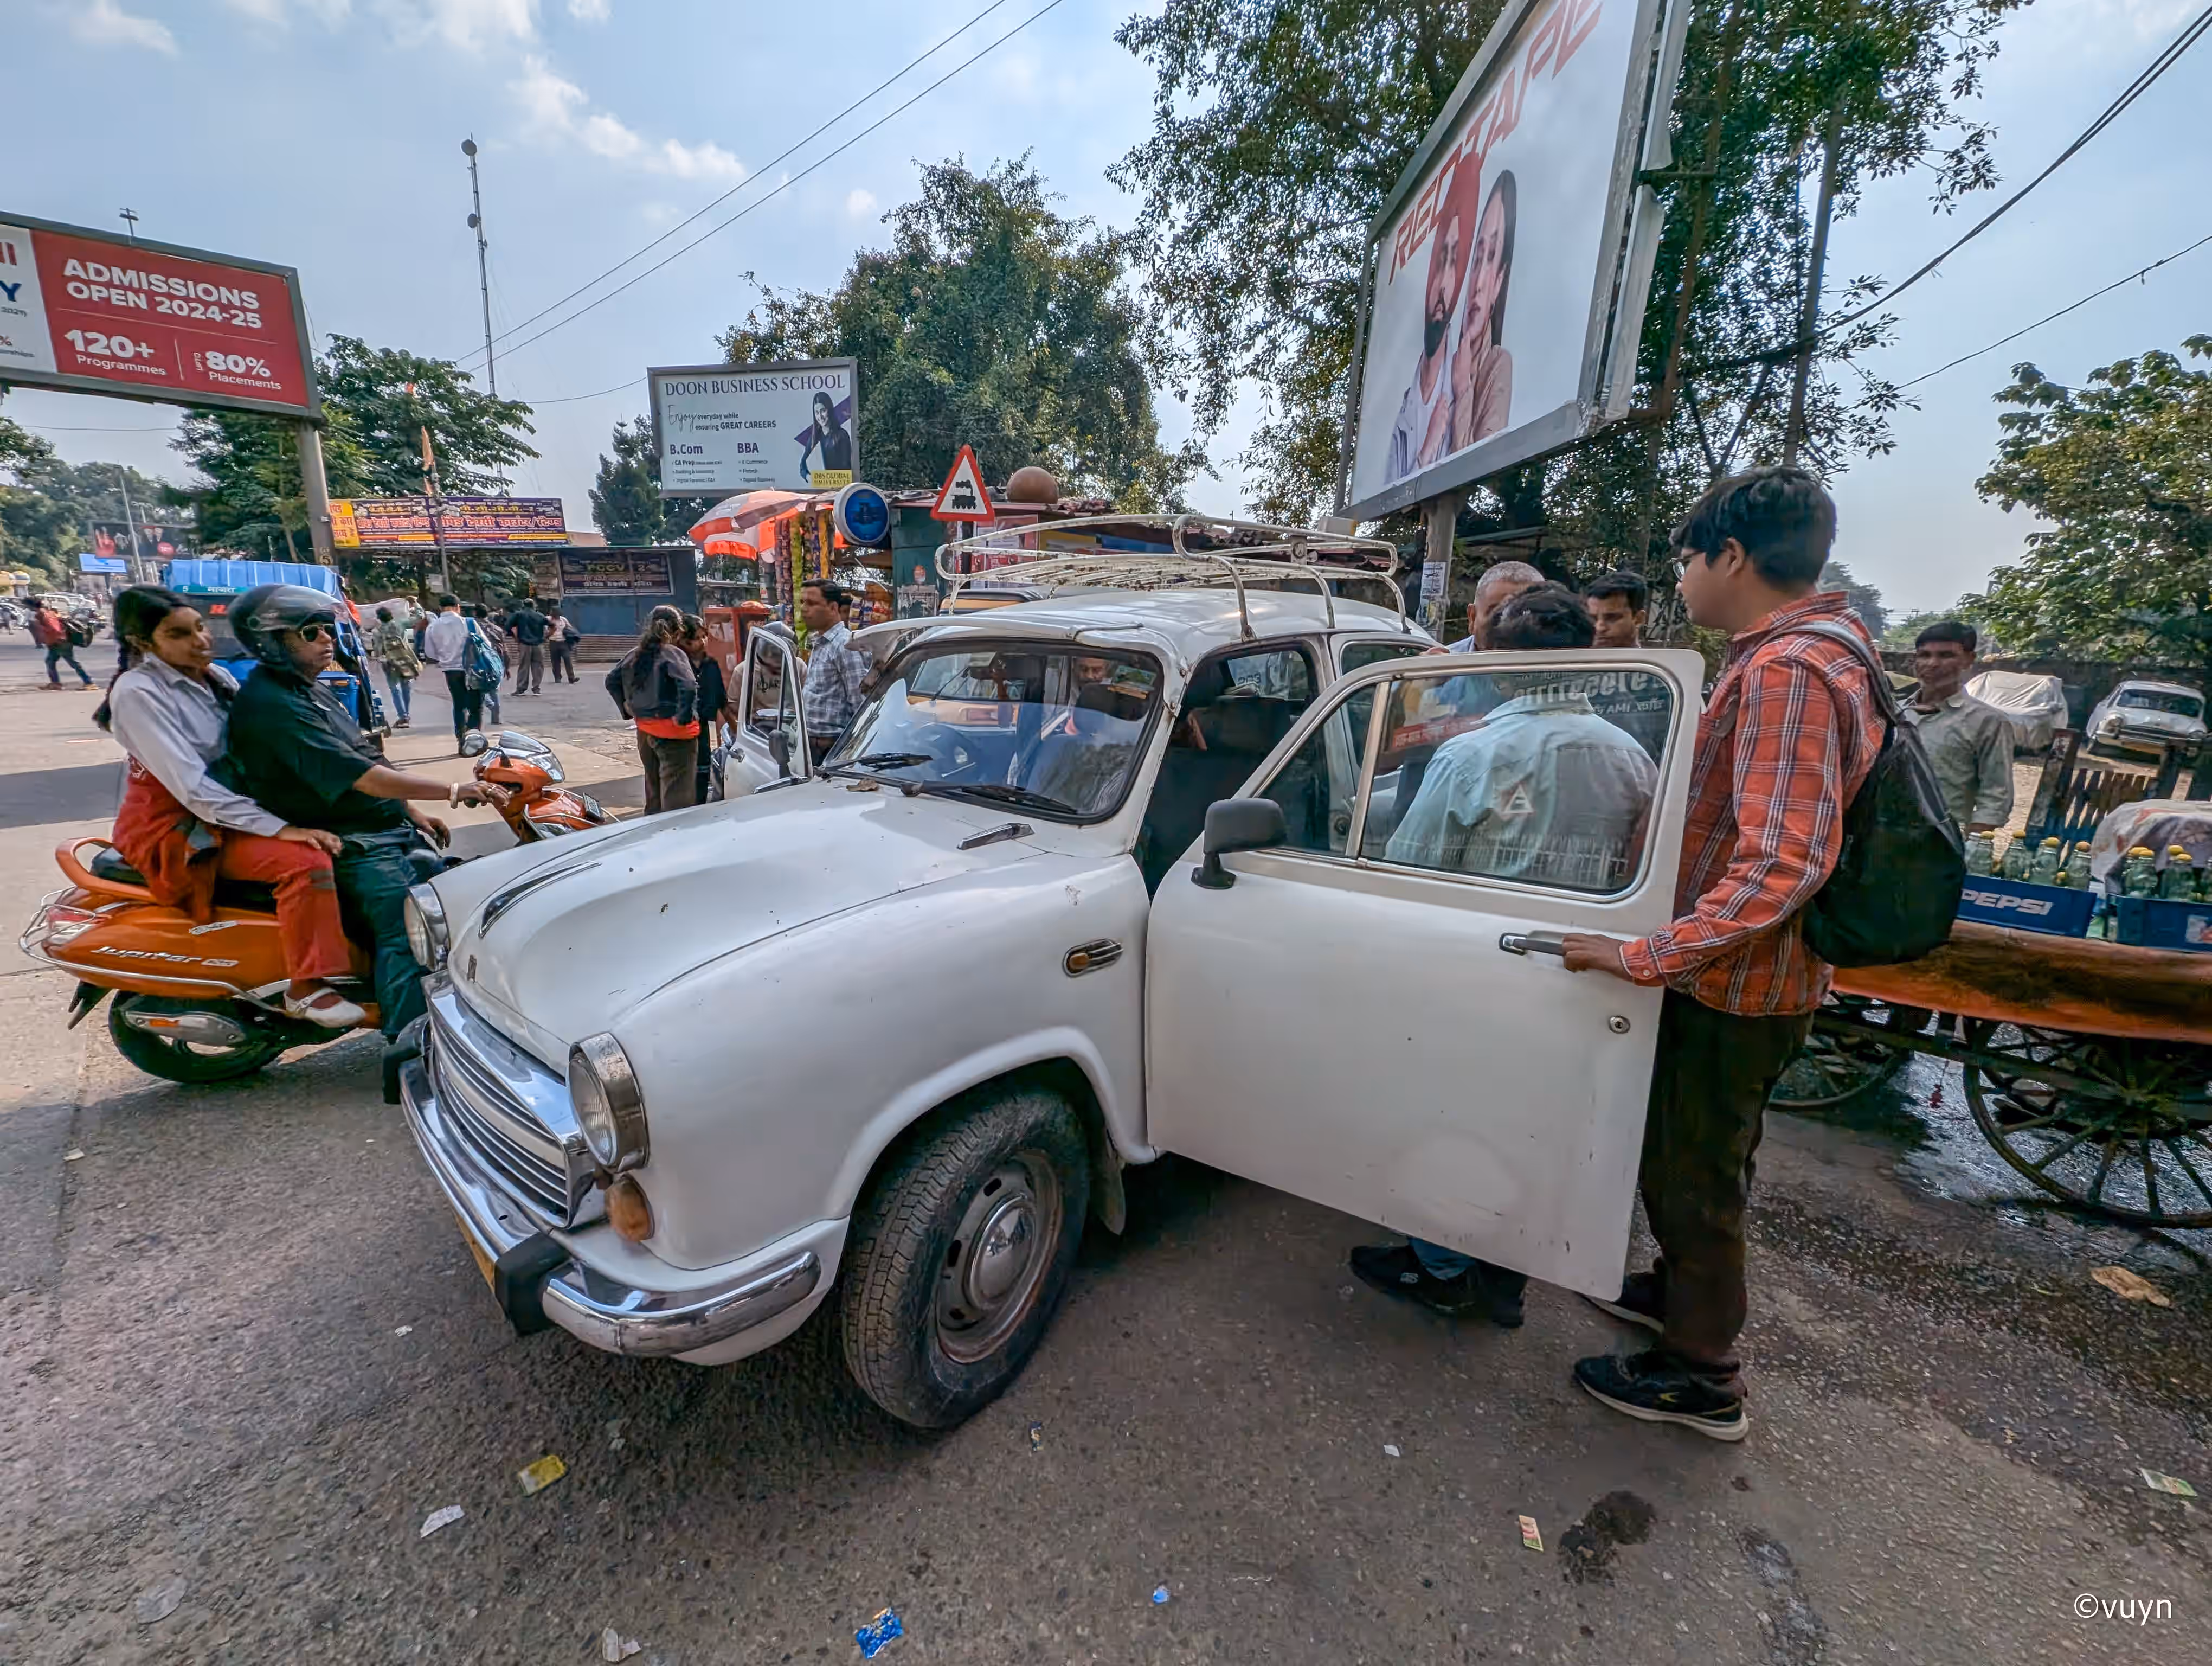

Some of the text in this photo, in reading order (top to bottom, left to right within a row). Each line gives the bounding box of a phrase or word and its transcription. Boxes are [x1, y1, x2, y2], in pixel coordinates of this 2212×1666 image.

[63, 258, 260, 309] ADMISSIONS
[66, 281, 262, 328] OPEN 2024-25
[65, 329, 155, 358] 120+
[76, 354, 167, 375] Programmes
[205, 351, 271, 377] 80%
[208, 371, 282, 390] Placements
[665, 374, 845, 395] DOON BUSINESS SCHOOL
[720, 421, 742, 430] GREAT
[744, 420, 776, 428] CAREERS
[670, 444, 703, 454] B.Com
[737, 442, 759, 453] BBA
[1961, 889, 2053, 916] PEPSI
[91, 946, 202, 963] Jupiter
